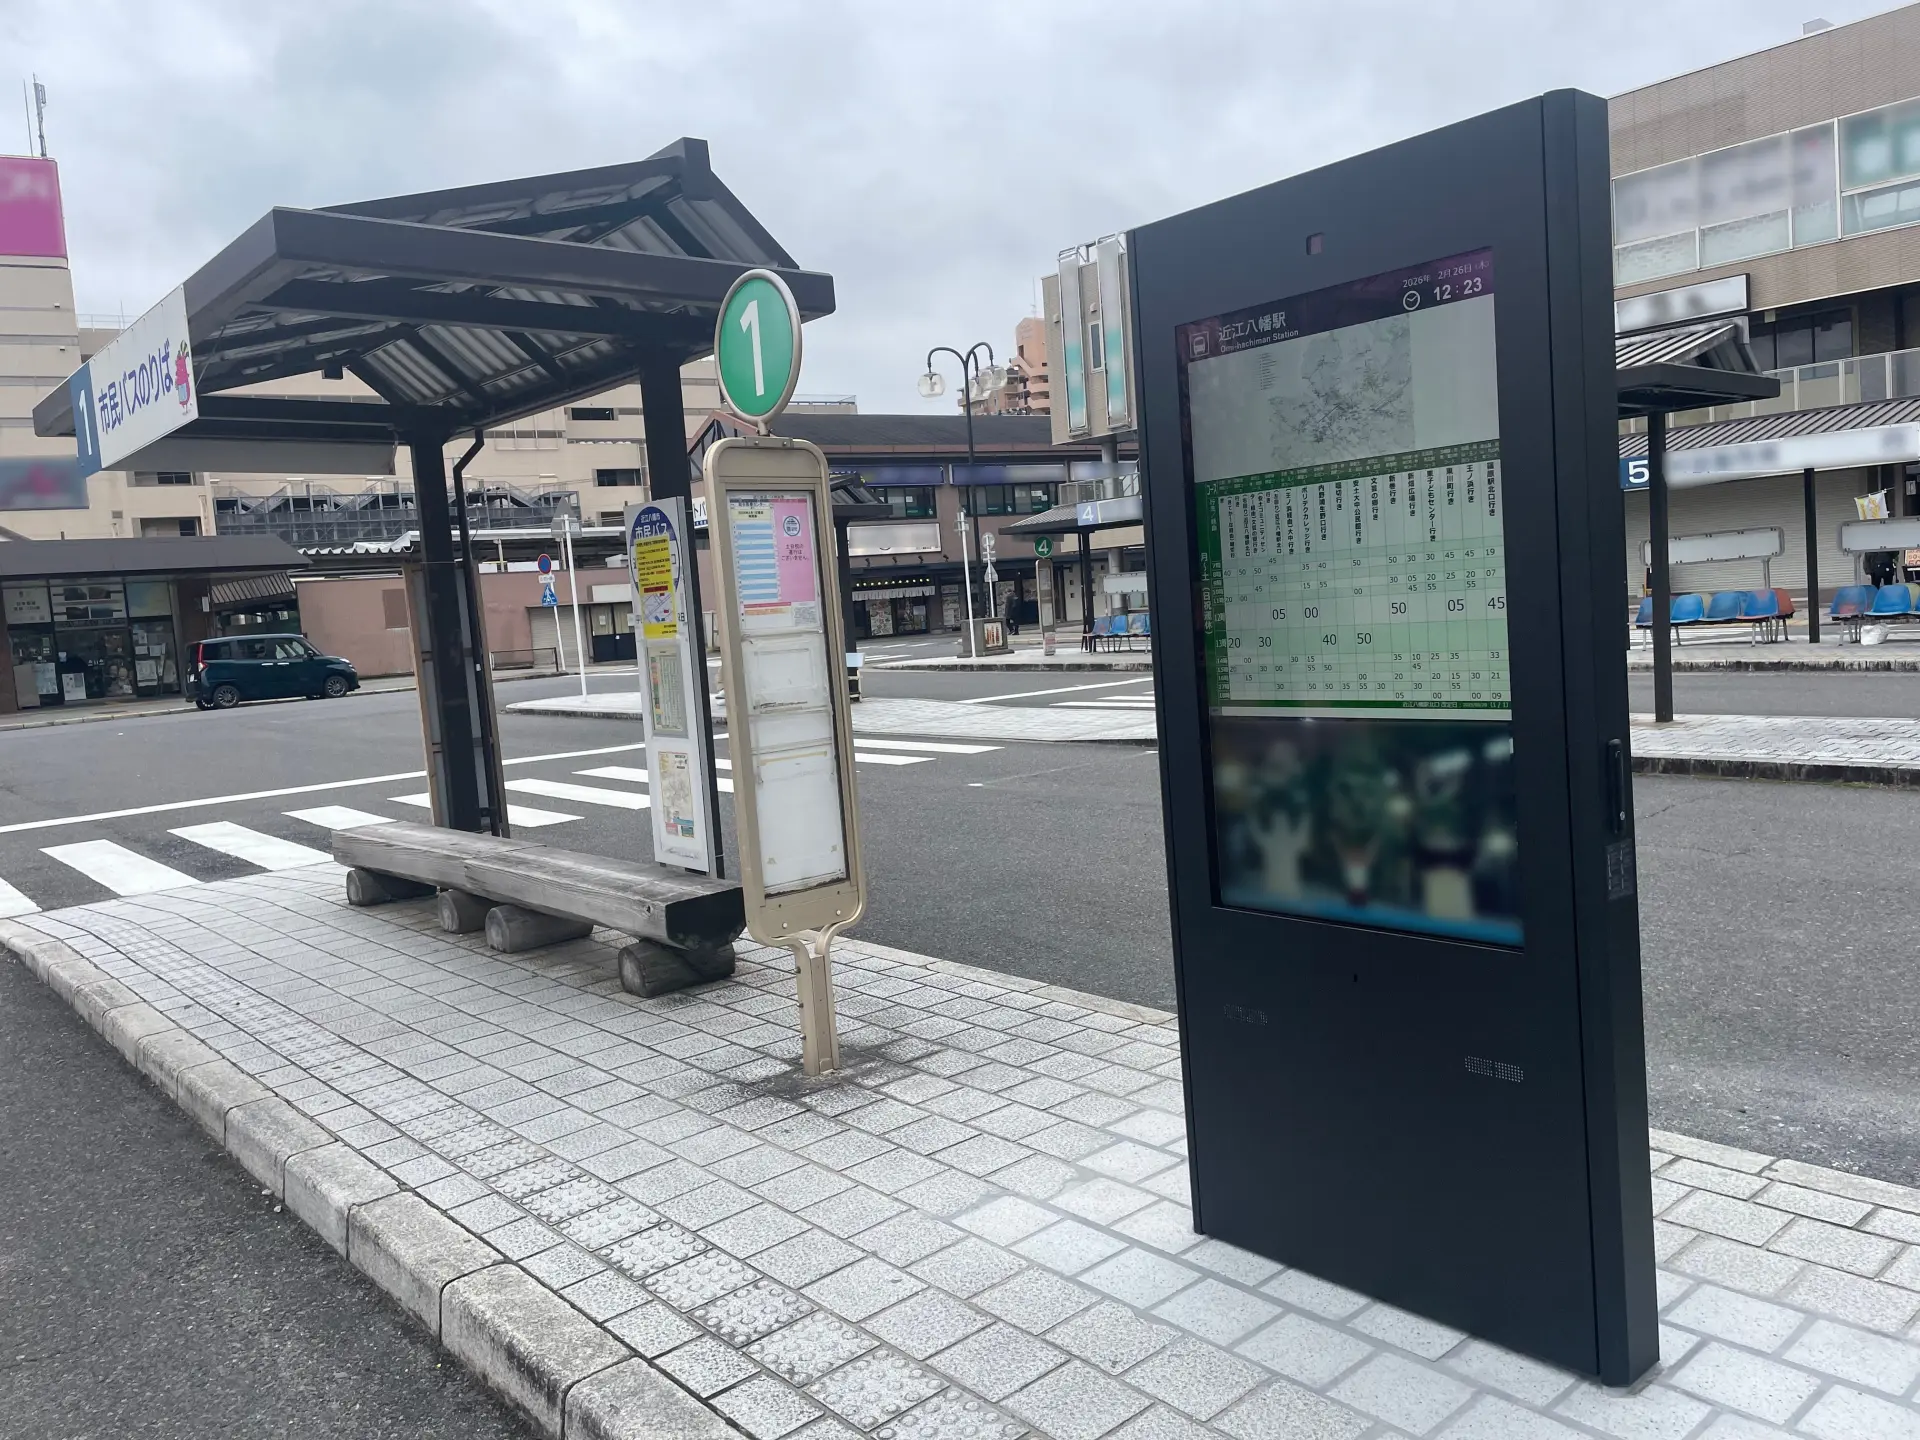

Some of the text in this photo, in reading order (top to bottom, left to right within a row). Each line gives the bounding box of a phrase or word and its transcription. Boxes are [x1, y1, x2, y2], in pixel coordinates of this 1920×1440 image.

[1402, 274, 1430, 287] 2026年
[1218, 311, 1286, 342] 近江八幡駅
[1272, 330, 1299, 341] Station
[739, 299, 765, 396] 1
[98, 338, 173, 434] 市民バスのりば
[79, 389, 92, 455] 1
[1628, 459, 1650, 484] 5
[1083, 505, 1094, 521] 4
[1038, 539, 1049, 554] 4
[1272, 609, 1286, 620] 05
[1304, 607, 1319, 618] 00
[1391, 602, 1406, 614] 50
[1447, 599, 1464, 611] 05
[1487, 597, 1505, 609] 45
[1228, 637, 1241, 648] 20
[1259, 636, 1272, 647] 30
[1322, 634, 1337, 645] 40
[1357, 633, 1372, 644] 50
